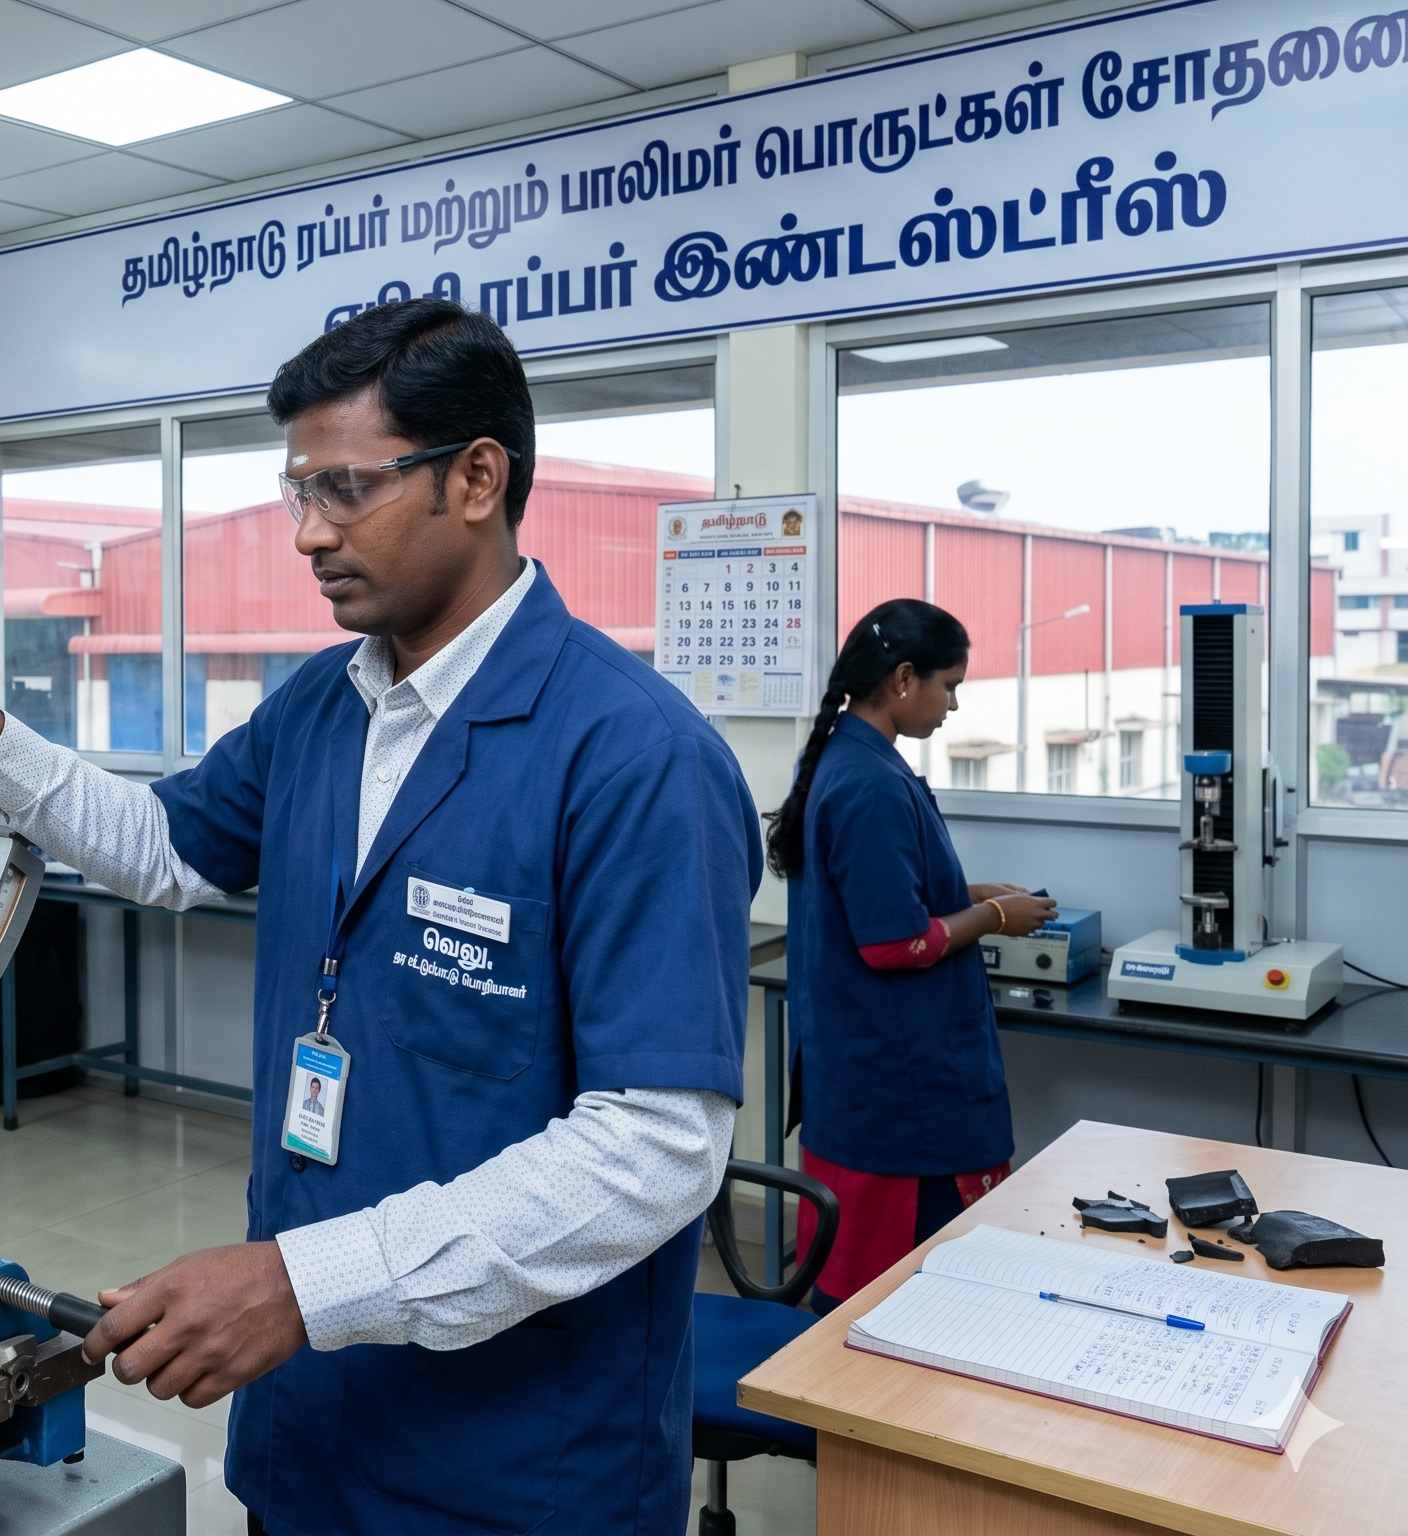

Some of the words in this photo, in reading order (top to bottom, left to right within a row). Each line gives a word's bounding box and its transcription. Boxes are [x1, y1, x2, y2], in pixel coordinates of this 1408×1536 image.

[121, 219, 287, 308] தமிழ்நாடு
[296, 193, 389, 272] ரப்பர்
[400, 162, 549, 255] மற்றும்
[560, 124, 741, 211] பாலிமர்
[754, 59, 1065, 181] பொருட்கள்
[653, 150, 1228, 303] இண்டஸ்ட்ரீஸ்
[725, 564, 731, 574] 1
[746, 563, 754, 574] 2
[768, 563, 777, 574] 3
[790, 562, 799, 573] 4
[681, 583, 689, 593] 6
[703, 583, 711, 593] 7
[724, 582, 732, 593] 8
[746, 582, 754, 592] 9
[766, 581, 780, 592] 10
[788, 581, 801, 591] 11
[678, 601, 692, 611] 13
[699, 601, 713, 611] 14
[721, 601, 735, 611] 15
[743, 600, 757, 611] 16
[765, 600, 779, 610] 17
[788, 599, 802, 610] 18
[678, 619, 692, 630] 19
[698, 619, 714, 629] 28
[720, 619, 733, 629] 21
[741, 619, 757, 629] 23
[763, 619, 779, 629] 24
[677, 637, 691, 647] 20
[698, 637, 713, 647] 28
[719, 637, 734, 647] 22
[741, 637, 756, 647] 23
[763, 637, 779, 647] 24
[676, 655, 691, 666] 27
[697, 655, 712, 666] 28
[718, 655, 734, 666] 29
[741, 655, 757, 666] 30
[763, 655, 777, 666] 31
